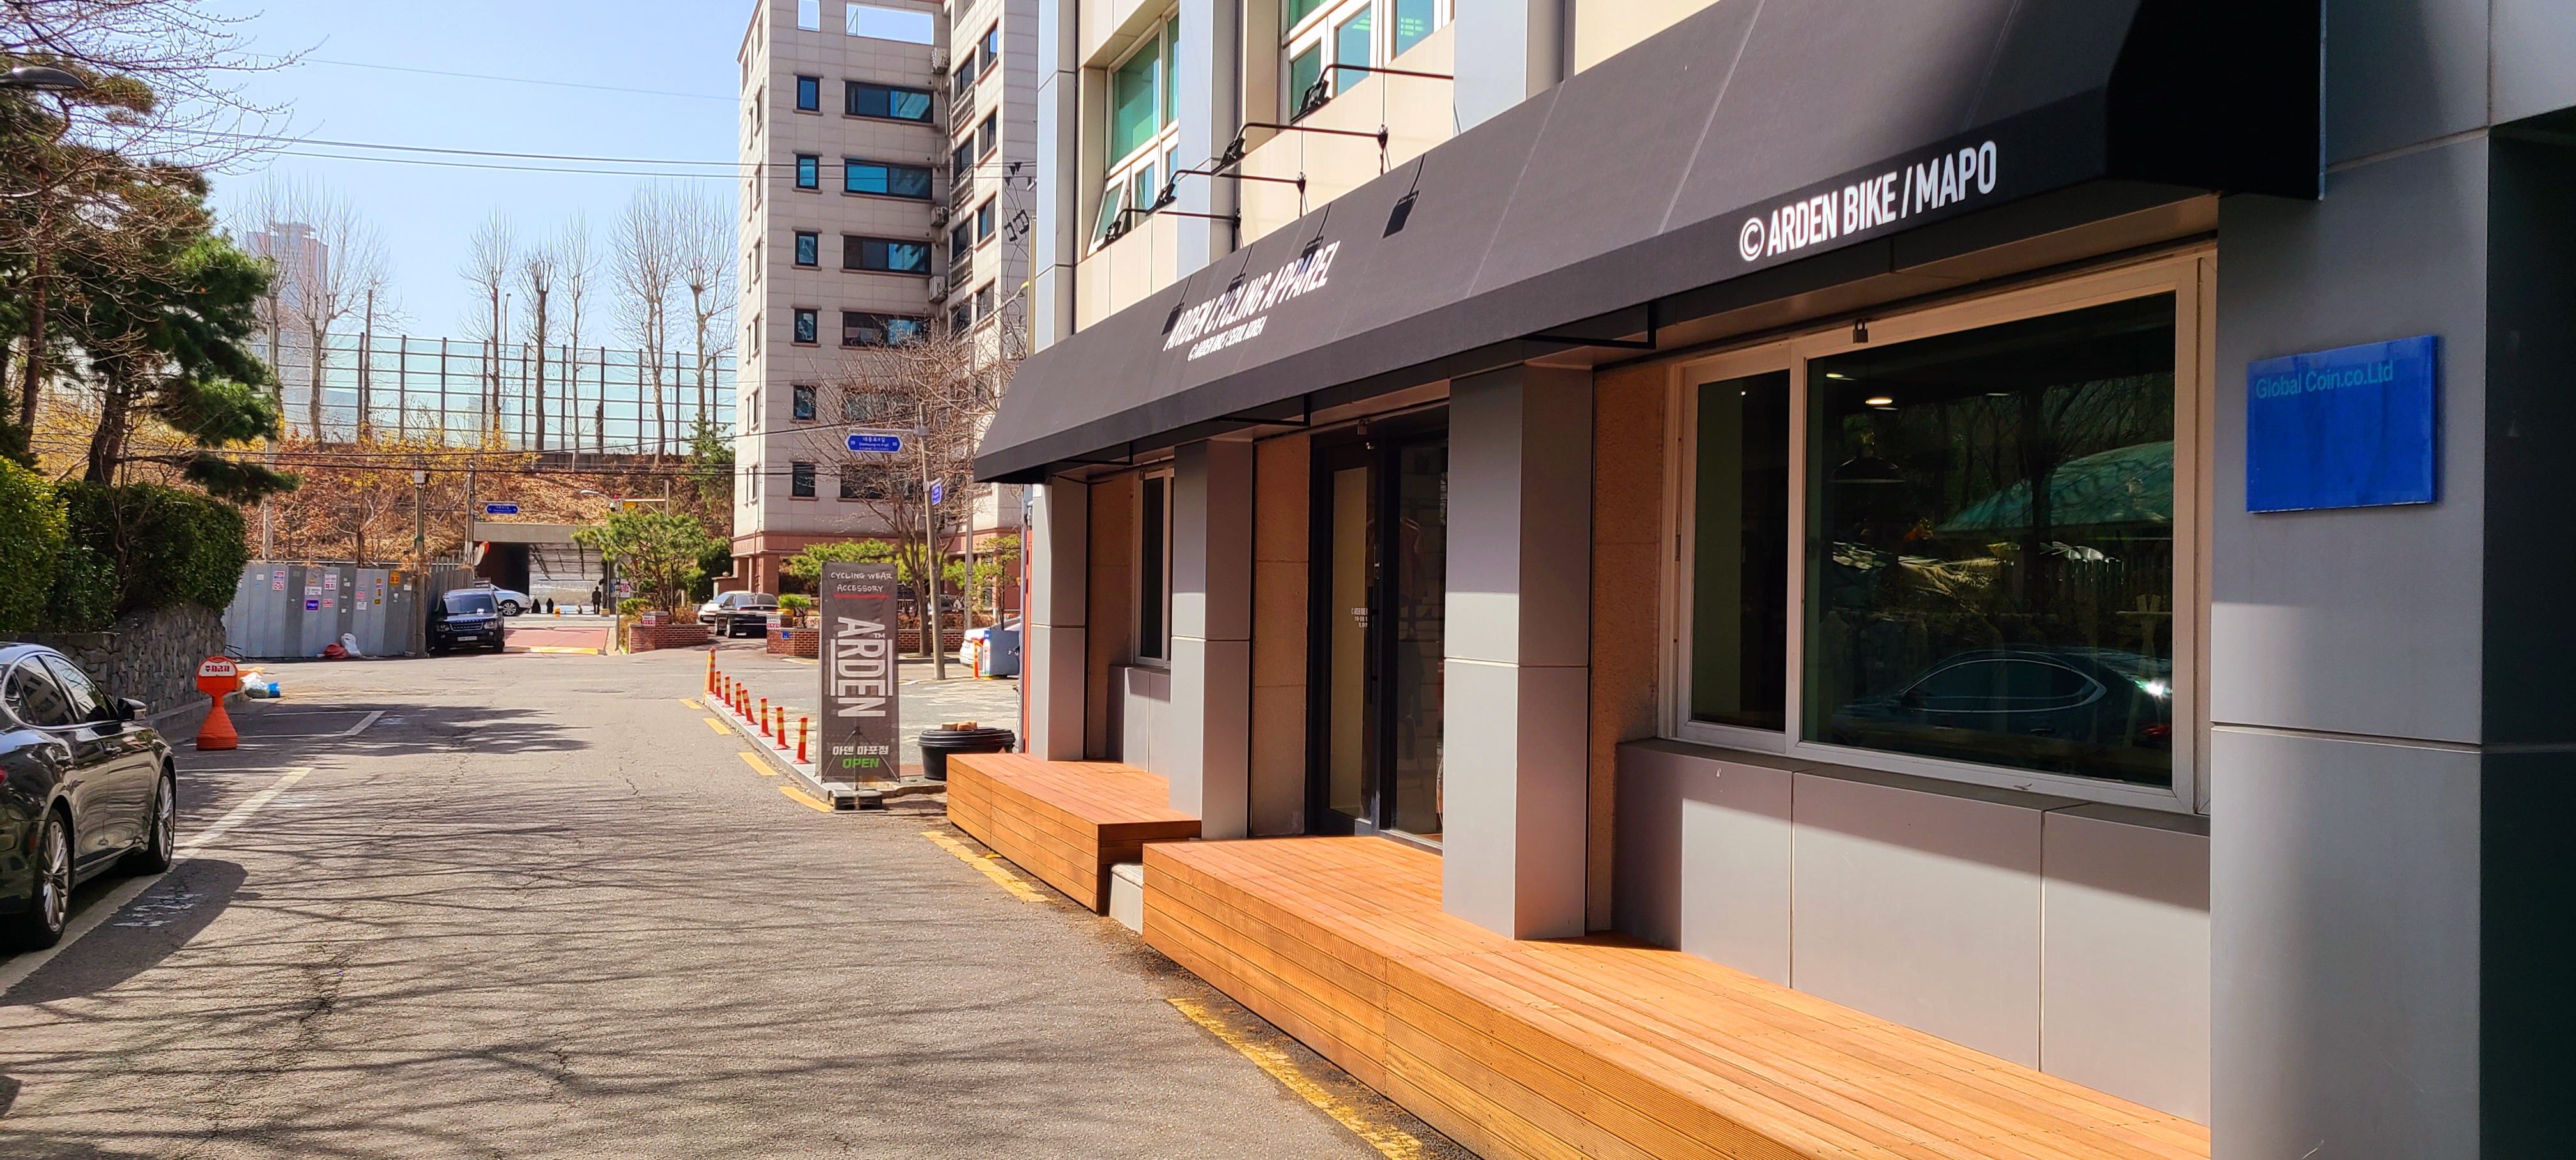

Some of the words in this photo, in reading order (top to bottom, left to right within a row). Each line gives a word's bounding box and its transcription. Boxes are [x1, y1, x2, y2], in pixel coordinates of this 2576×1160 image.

[1843, 172, 1897, 236] BIKE
[1916, 141, 1997, 214] MAPO
[1163, 297, 1214, 351] ARDEN
[1204, 272, 1272, 335] CYCLING
[1259, 241, 1340, 312] APPAREL
[2257, 372, 2302, 399] Global
[831, 572, 866, 580] CYCLING
[868, 572, 893, 581] WEAR
[837, 584, 884, 593] ACCESSORY
[838, 616, 886, 717] ARDEN
[832, 745, 855, 756] 아덴
[857, 745, 889, 755] 마포점
[842, 758, 880, 768] OPEN
